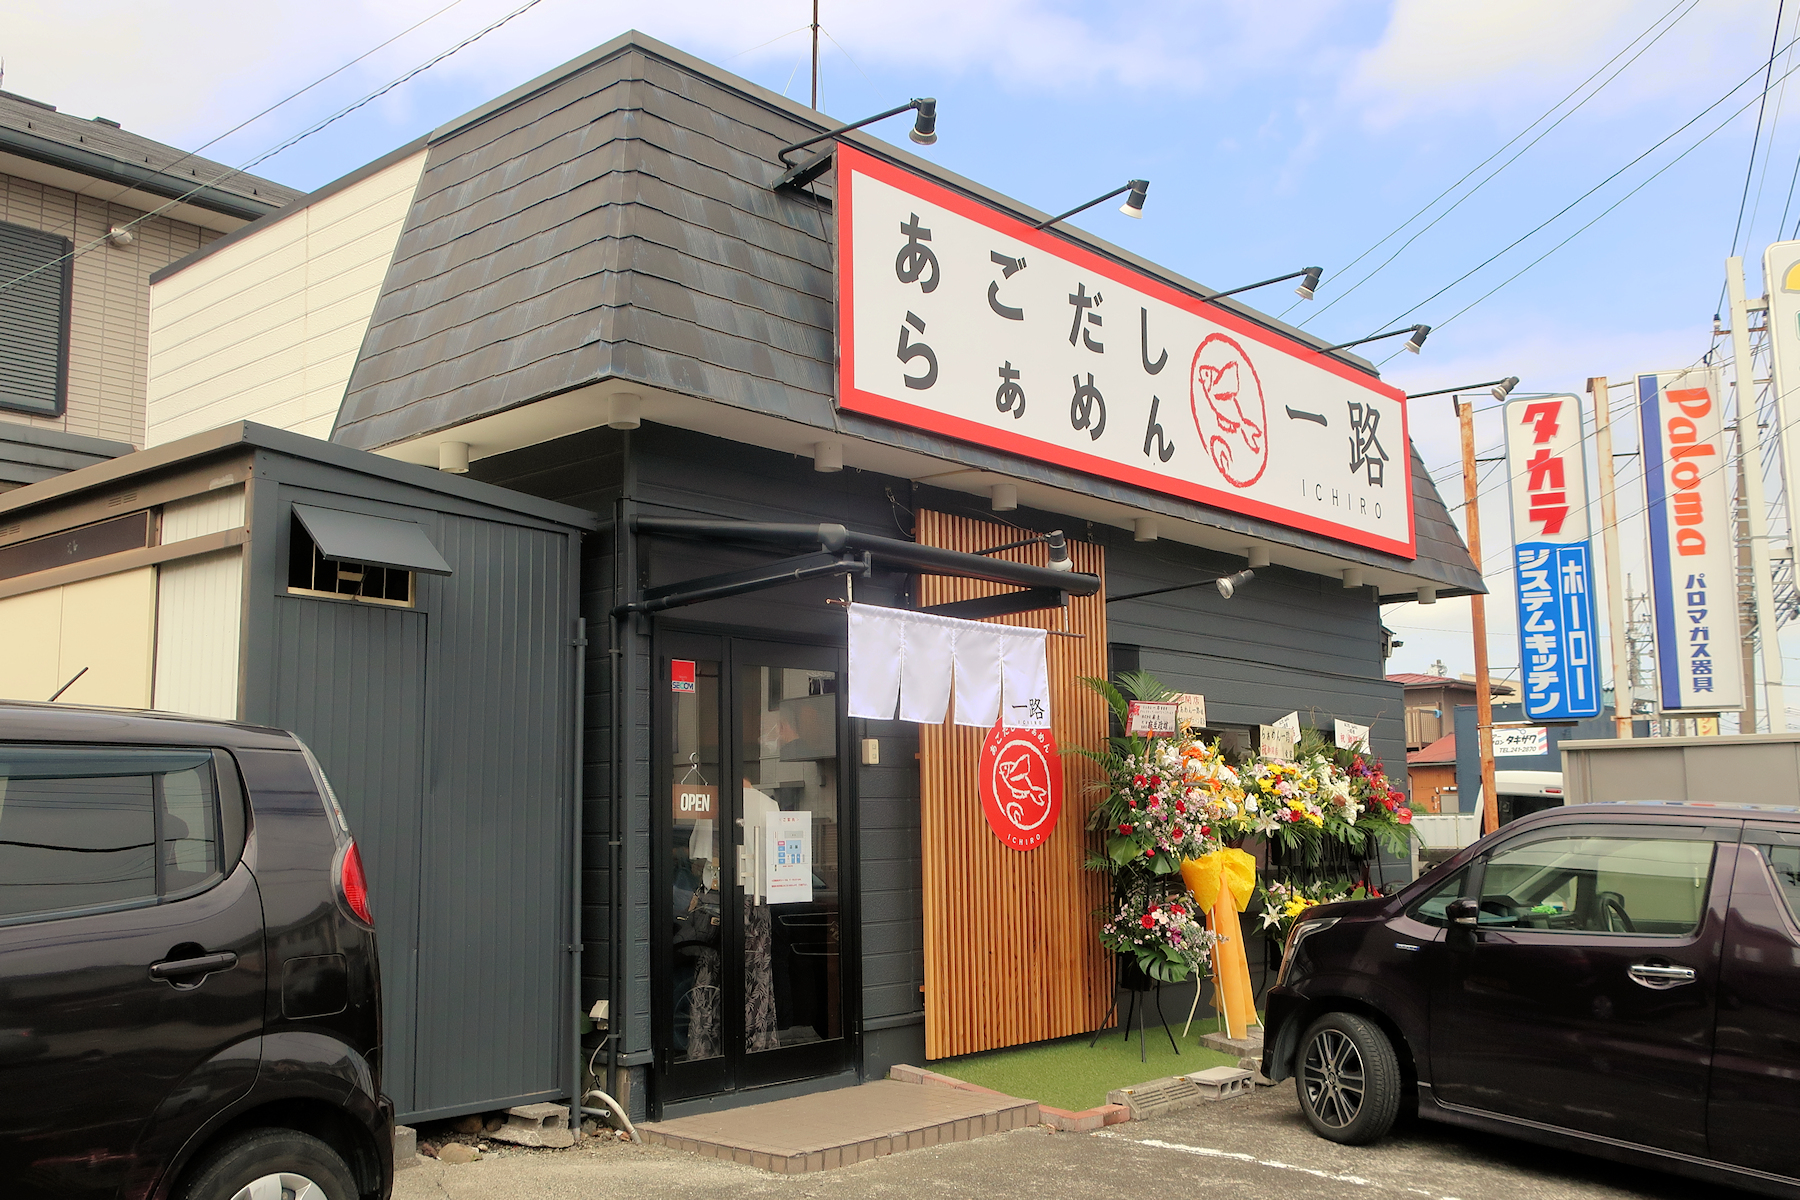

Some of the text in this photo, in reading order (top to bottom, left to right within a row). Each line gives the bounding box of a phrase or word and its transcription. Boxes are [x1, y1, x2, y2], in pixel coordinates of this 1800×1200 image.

[896, 212, 1168, 375] あごだし
[897, 310, 1175, 463] らぁめん
[1285, 401, 1389, 488] 一路
[1302, 479, 1381, 519] ICHIRO
[1520, 400, 1570, 535] タカラ
[1665, 387, 1716, 557] Paloma
[673, 682, 693, 690] SECOM
[1519, 549, 1560, 714] システムキッチン
[1562, 560, 1586, 700] ホーロー
[1685, 573, 1714, 693] パロマガス器具
[1012, 698, 1045, 720] 一路
[680, 793, 710, 811] OPEN
[1007, 834, 1041, 845] ICHIRO
